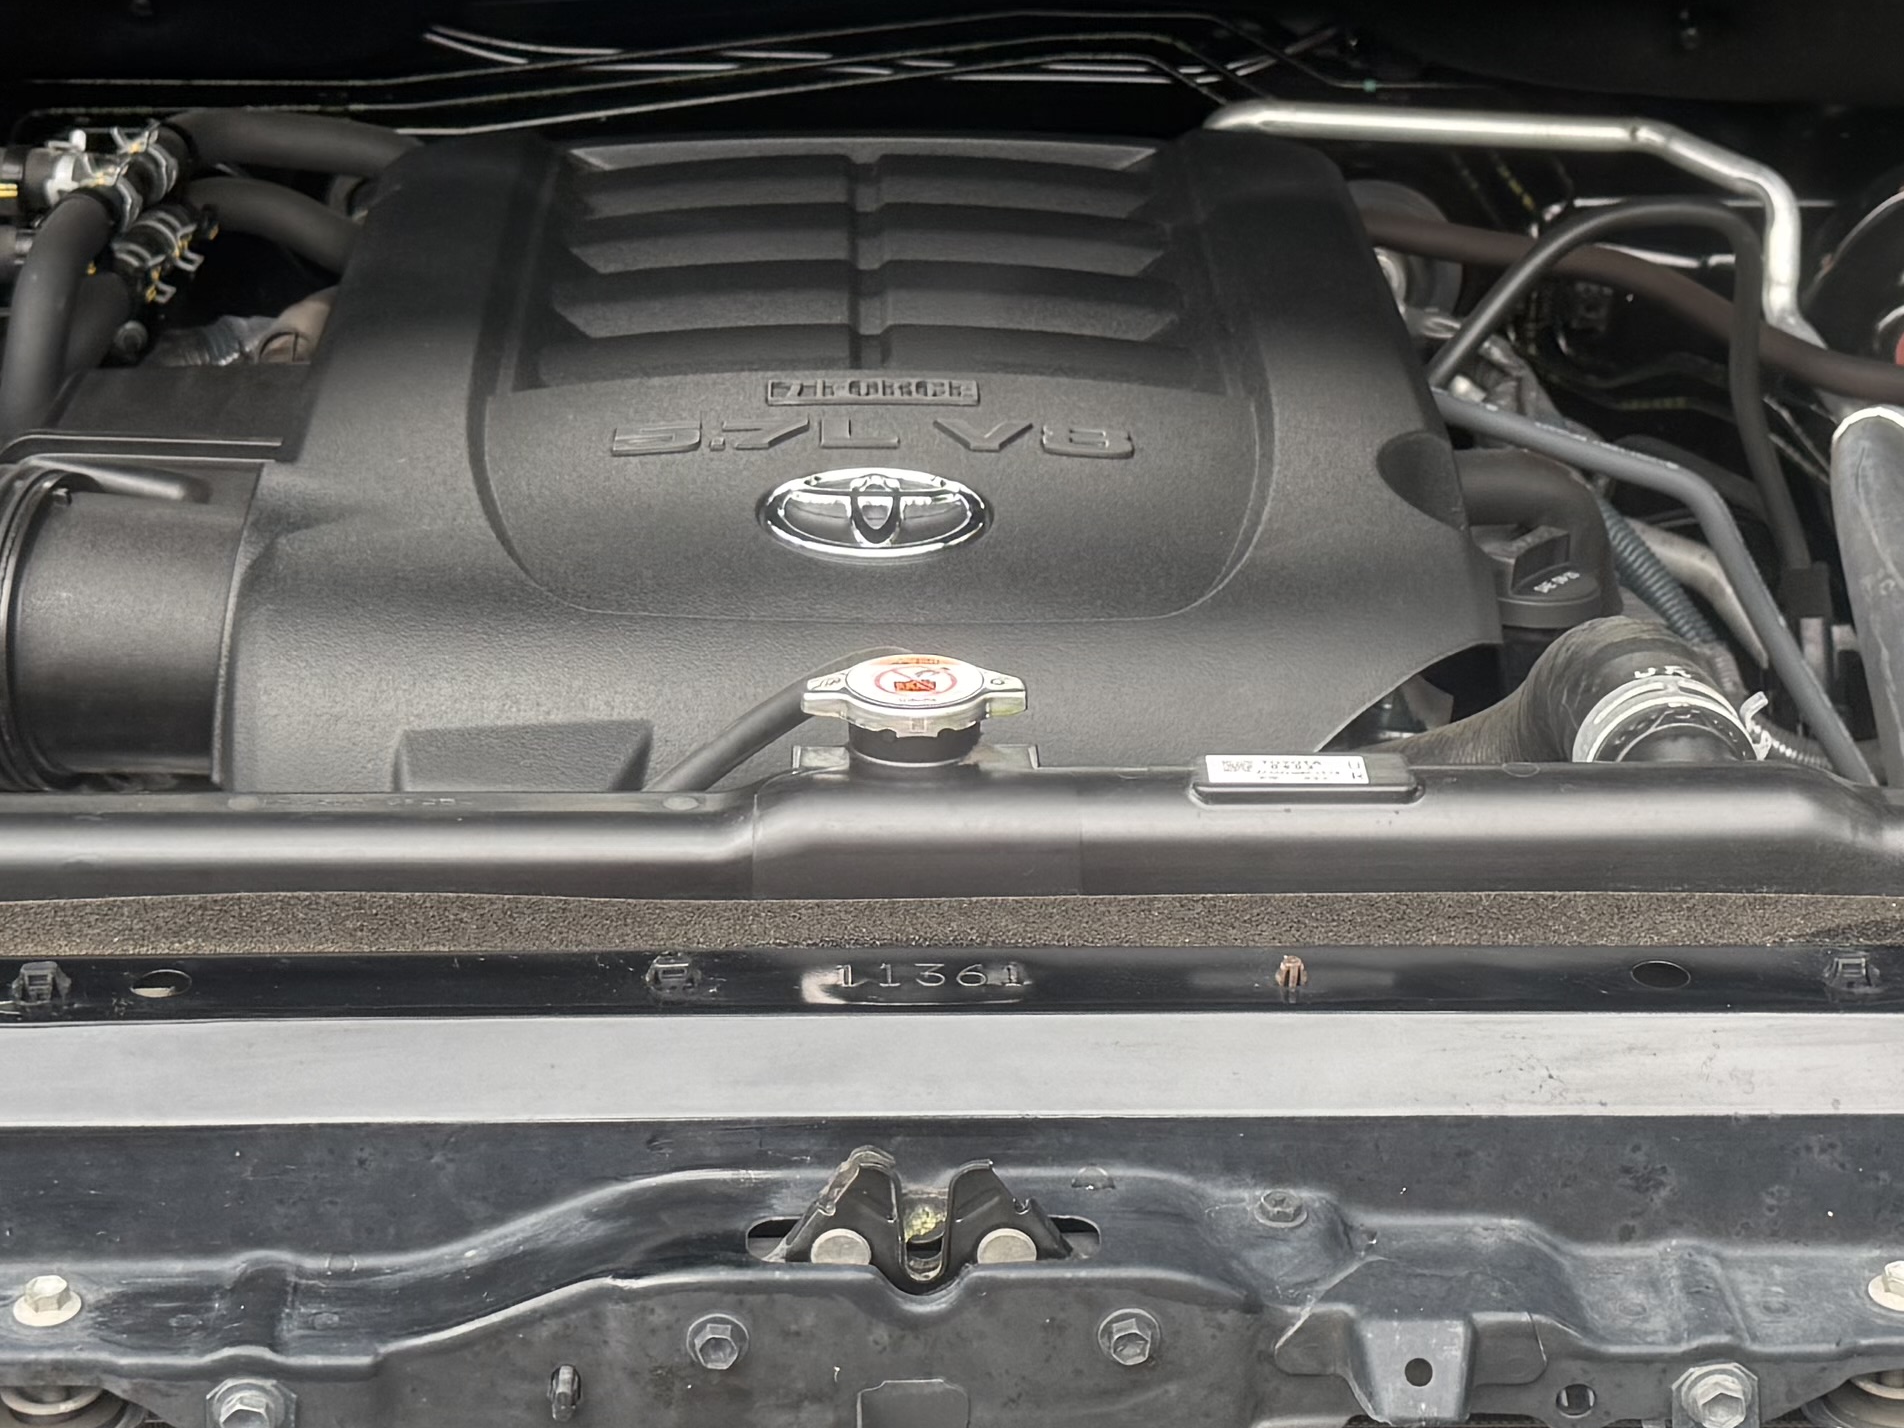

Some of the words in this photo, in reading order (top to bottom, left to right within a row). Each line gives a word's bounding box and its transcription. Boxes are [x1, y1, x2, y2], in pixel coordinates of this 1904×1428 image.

[610, 416, 901, 457] 5.7L
[932, 418, 1135, 458] V8
[834, 961, 1027, 988] 11361
